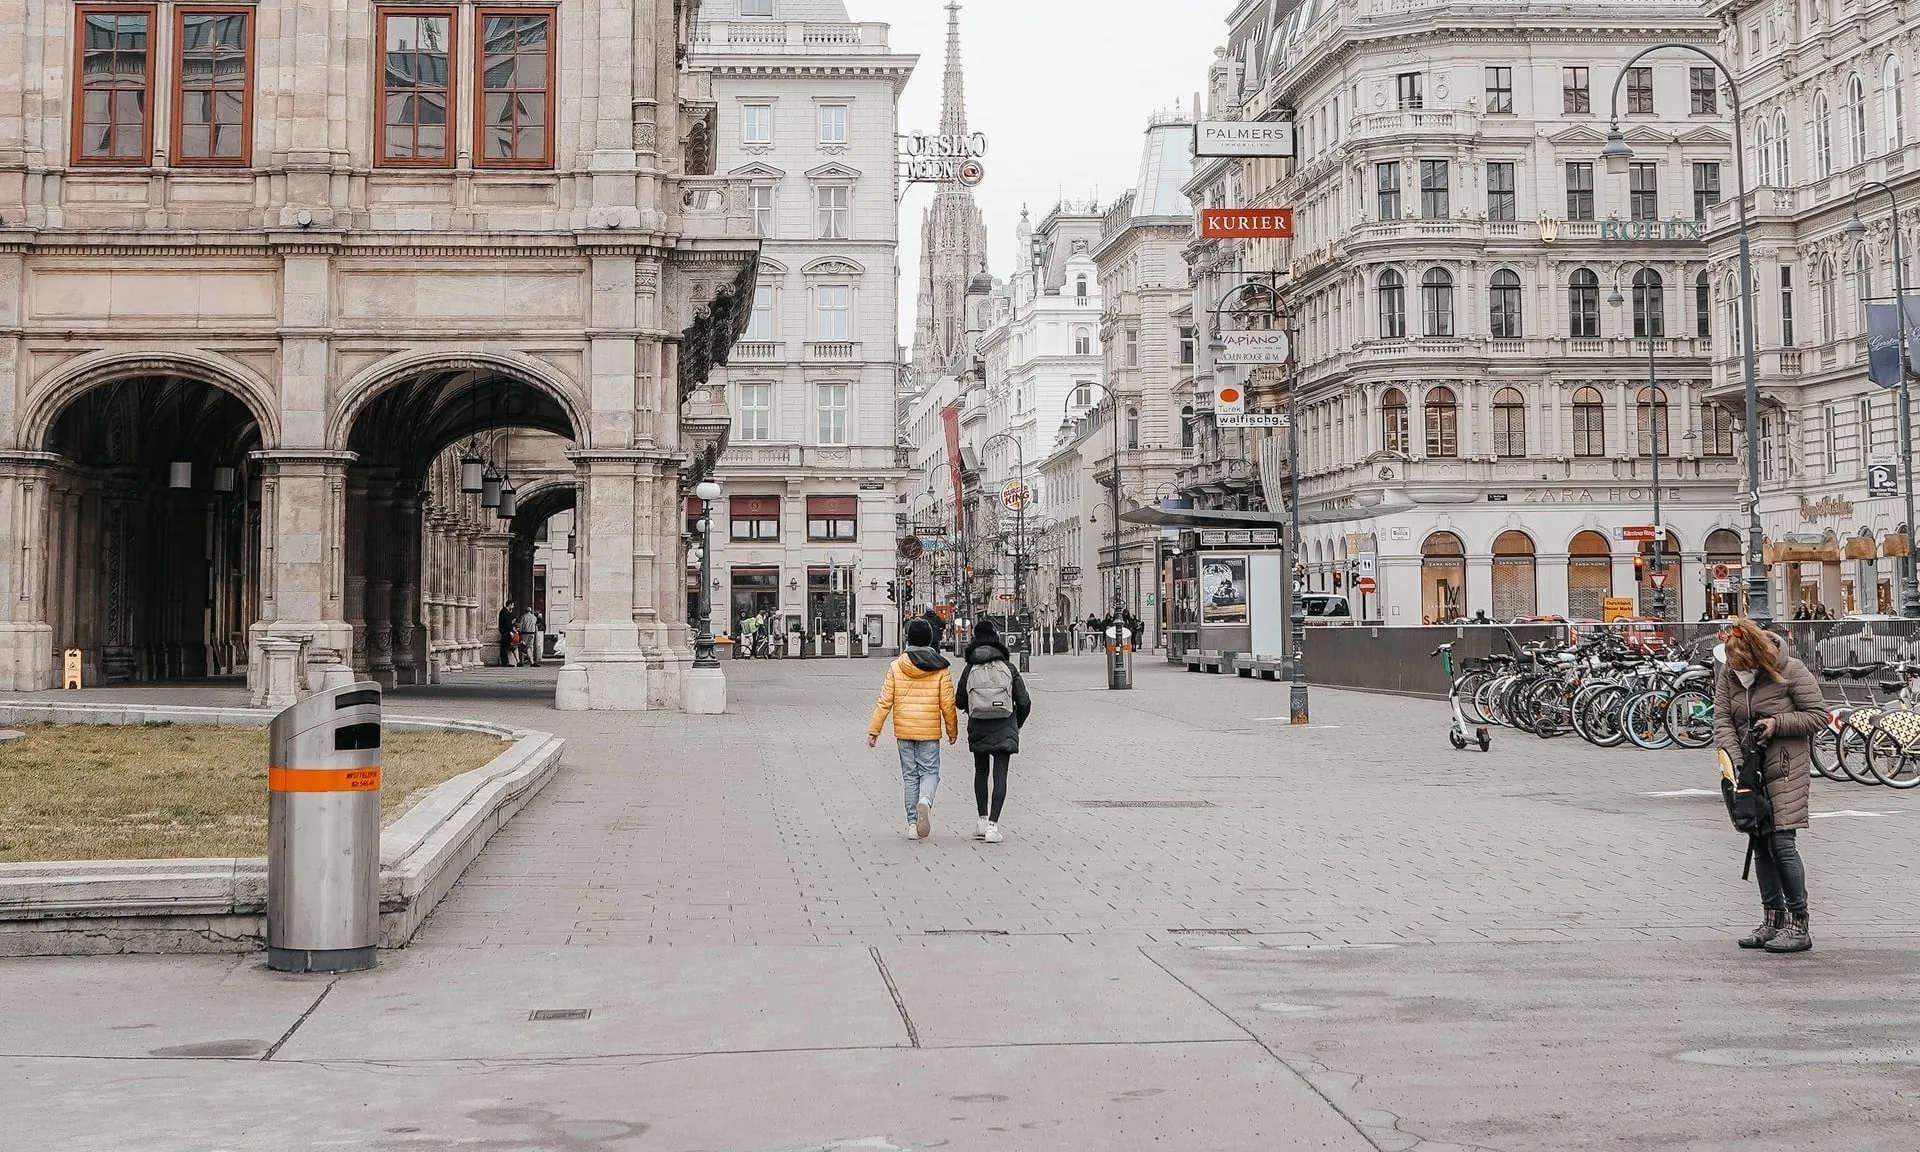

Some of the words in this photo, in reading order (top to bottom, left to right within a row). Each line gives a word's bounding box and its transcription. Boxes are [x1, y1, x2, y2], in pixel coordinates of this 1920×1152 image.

[1206, 128, 1284, 139] PALMERS
[1208, 216, 1286, 230] KURIER
[1005, 491, 1029, 505] KING
[1523, 488, 1594, 502] ZARA
[1610, 488, 1680, 502] HOME
